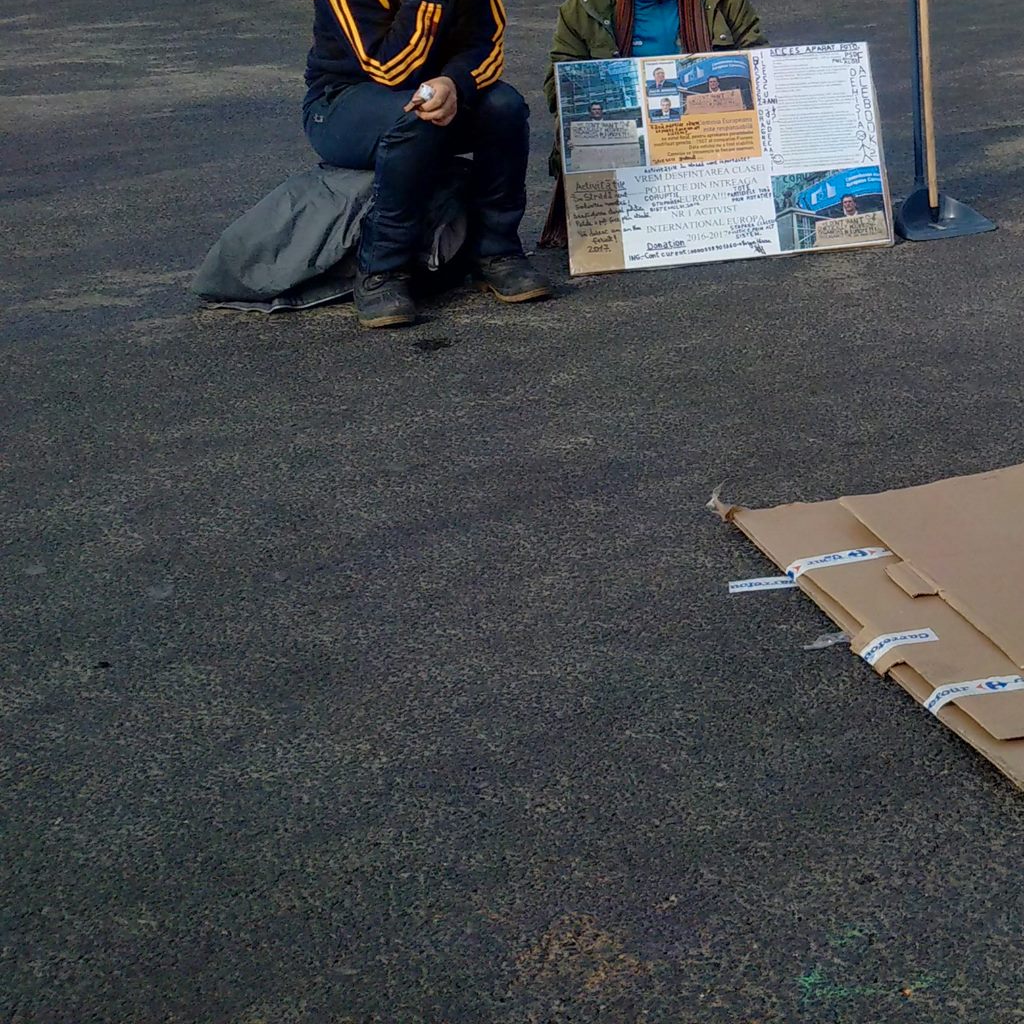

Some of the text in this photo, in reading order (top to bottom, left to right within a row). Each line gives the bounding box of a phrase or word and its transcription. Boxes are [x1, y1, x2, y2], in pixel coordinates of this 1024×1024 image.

[634, 173, 663, 184] VREM
[664, 166, 730, 181] DESFINTAREA
[731, 163, 766, 175] CLASEI
[645, 182, 689, 194] POLITICE
[690, 179, 707, 191] DIN
[709, 175, 758, 189] INTREAGA
[671, 209, 686, 218] NR
[695, 204, 738, 217] ACTIVIST
[646, 218, 724, 234] INTERNATIONAL
[726, 215, 765, 226] EUROPA
[646, 239, 686, 251] Donation
